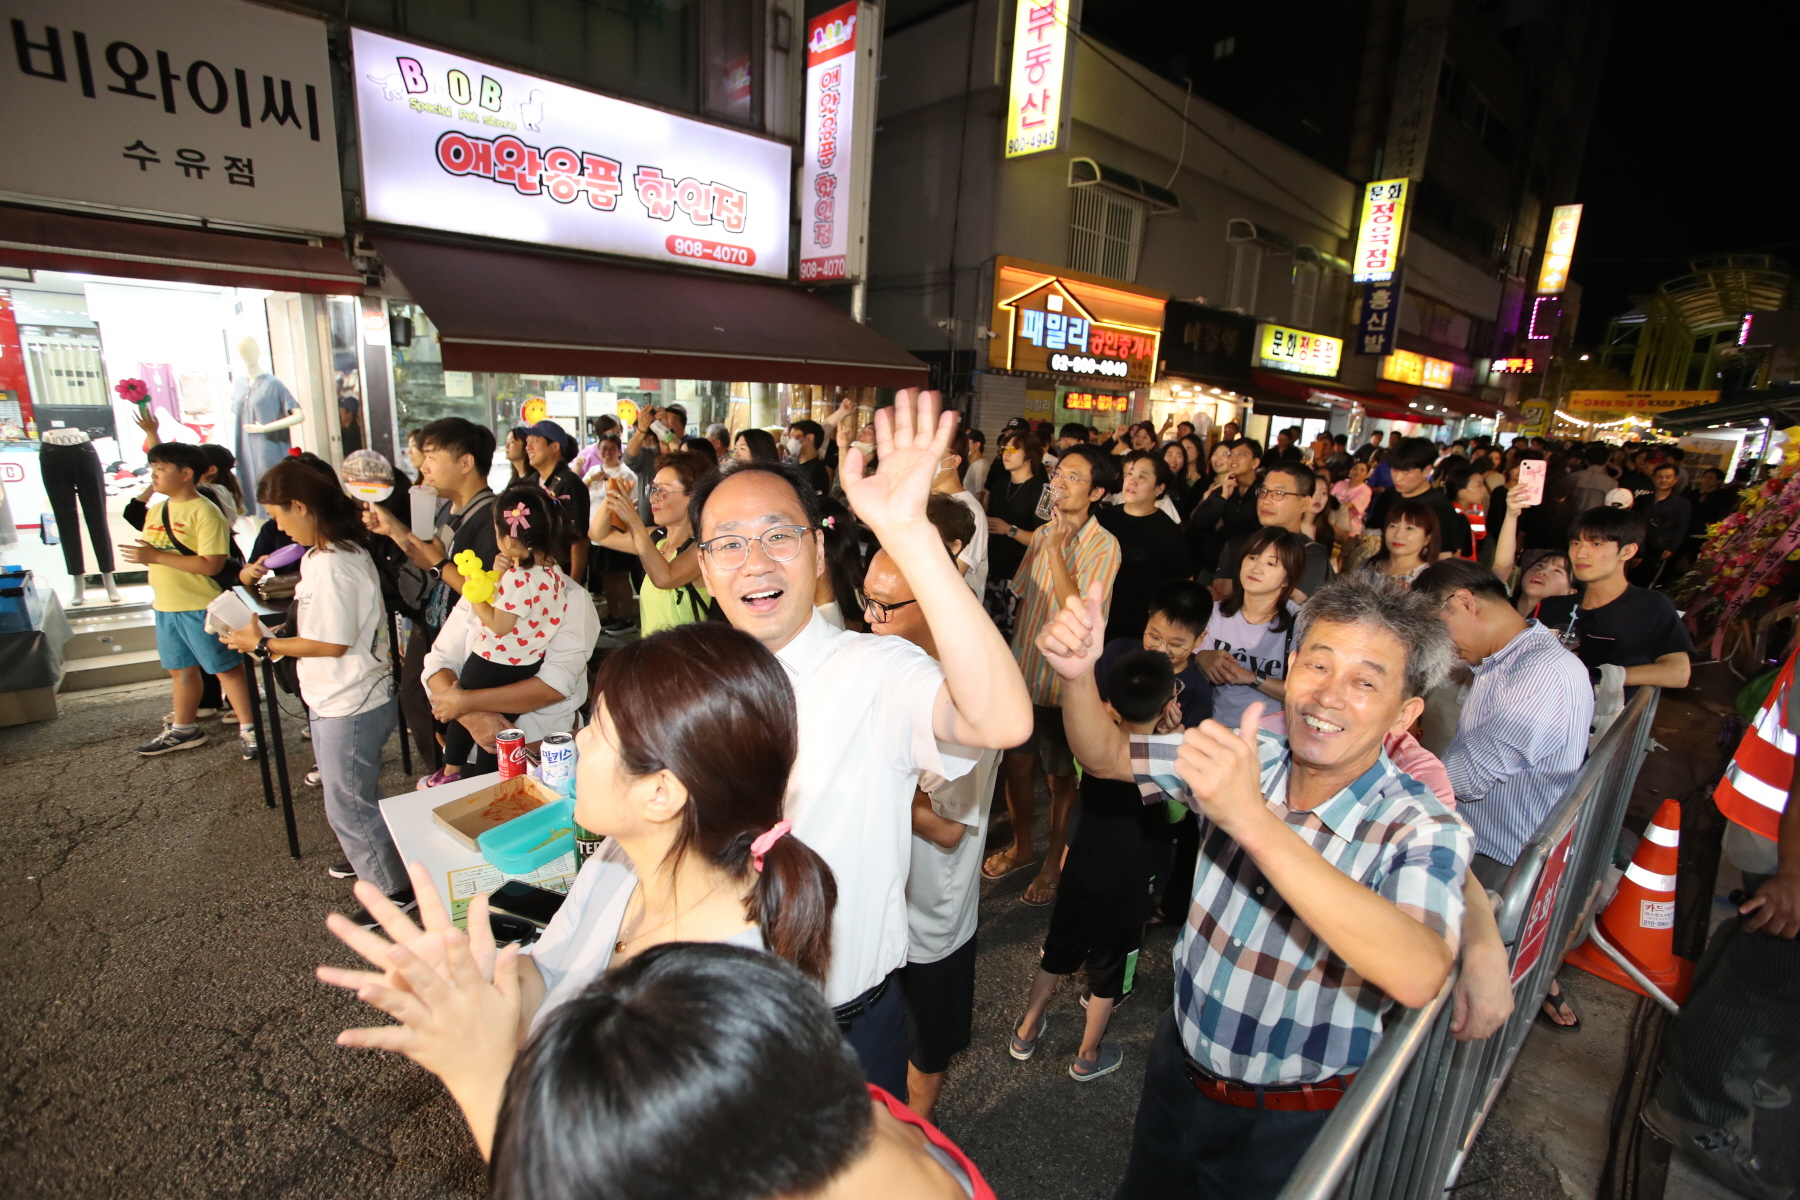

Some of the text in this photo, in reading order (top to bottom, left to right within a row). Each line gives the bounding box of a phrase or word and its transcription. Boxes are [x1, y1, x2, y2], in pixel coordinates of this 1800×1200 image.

[10, 17, 321, 142] 비와이씨
[1021, 1, 1057, 130] 부동산
[408, 97, 452, 118] Special
[482, 114, 517, 131] store
[1008, 131, 1055, 154] 900-4949
[123, 139, 256, 188] 수유점
[437, 131, 746, 232] 애완용품 할인점
[814, 172, 837, 248] 할인점
[1370, 183, 1402, 201] 문화
[674, 238, 748, 264] 908-4070
[1366, 202, 1396, 268] 정육점
[800, 259, 846, 279] 908-4070
[1021, 308, 1090, 353] 패밀리
[1090, 329, 1155, 361] 공인중개사
[541, 748, 573, 764] 밀키스
[1644, 903, 1665, 912] 카드
